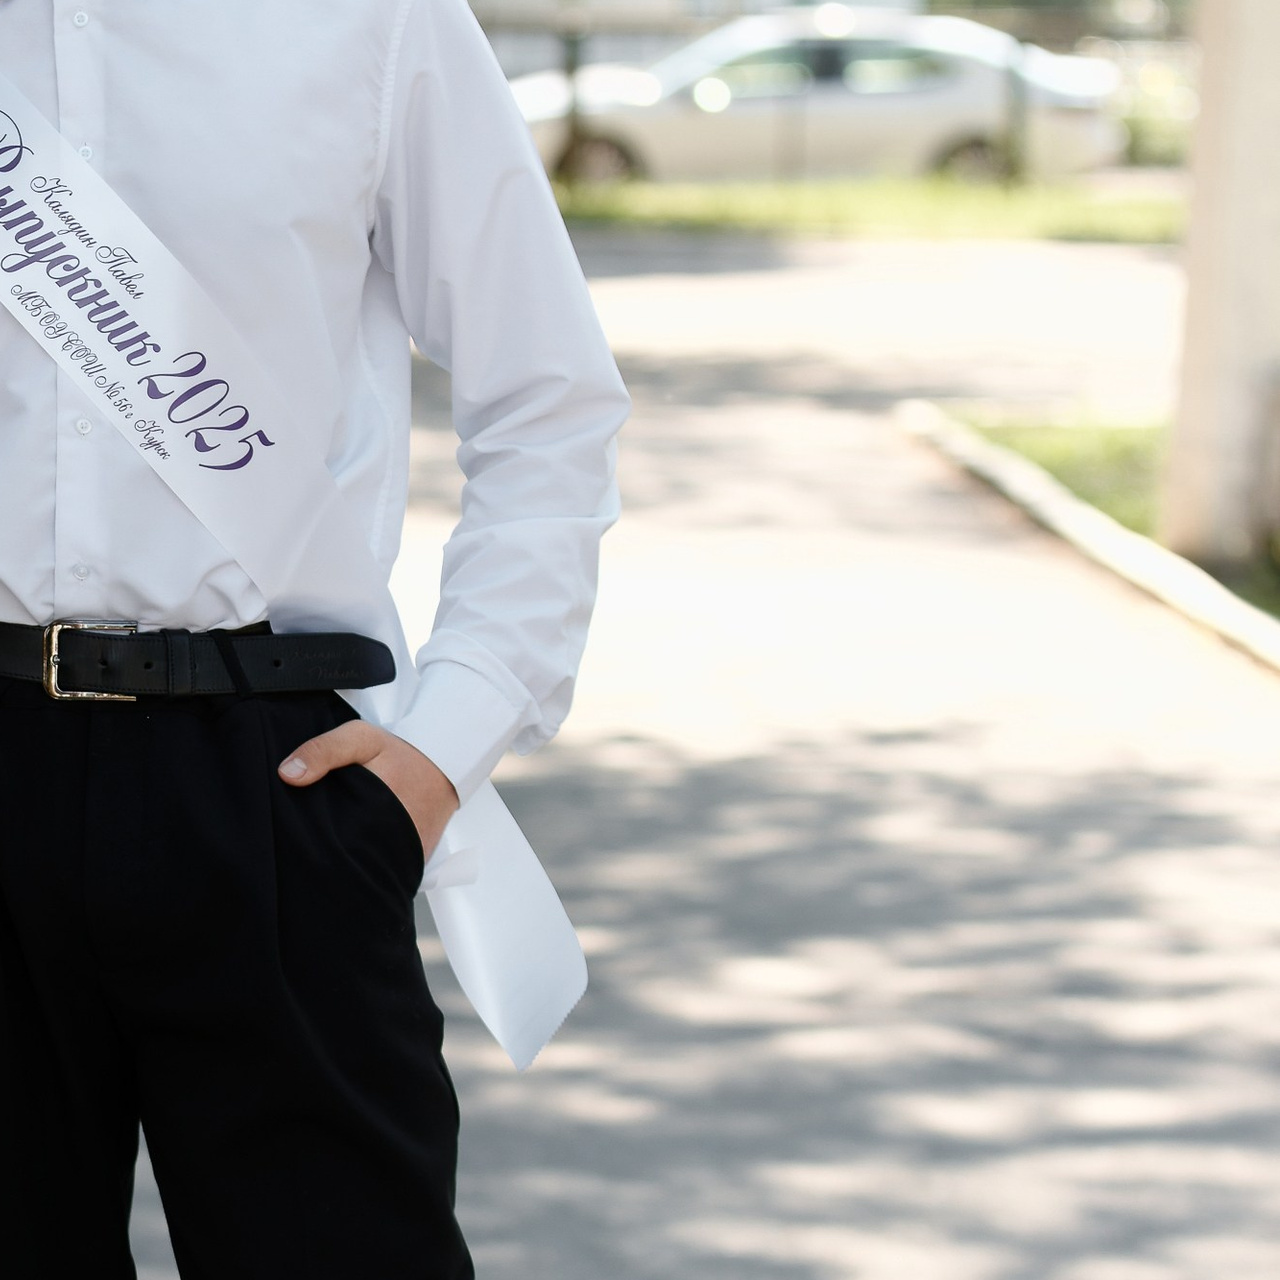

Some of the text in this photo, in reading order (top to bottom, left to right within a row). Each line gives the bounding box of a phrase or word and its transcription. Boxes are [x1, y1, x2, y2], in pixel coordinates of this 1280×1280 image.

[30, 175, 144, 300] Калядин Павел
[133, 419, 171, 460] Курск
[137, 351, 275, 471] 2025
